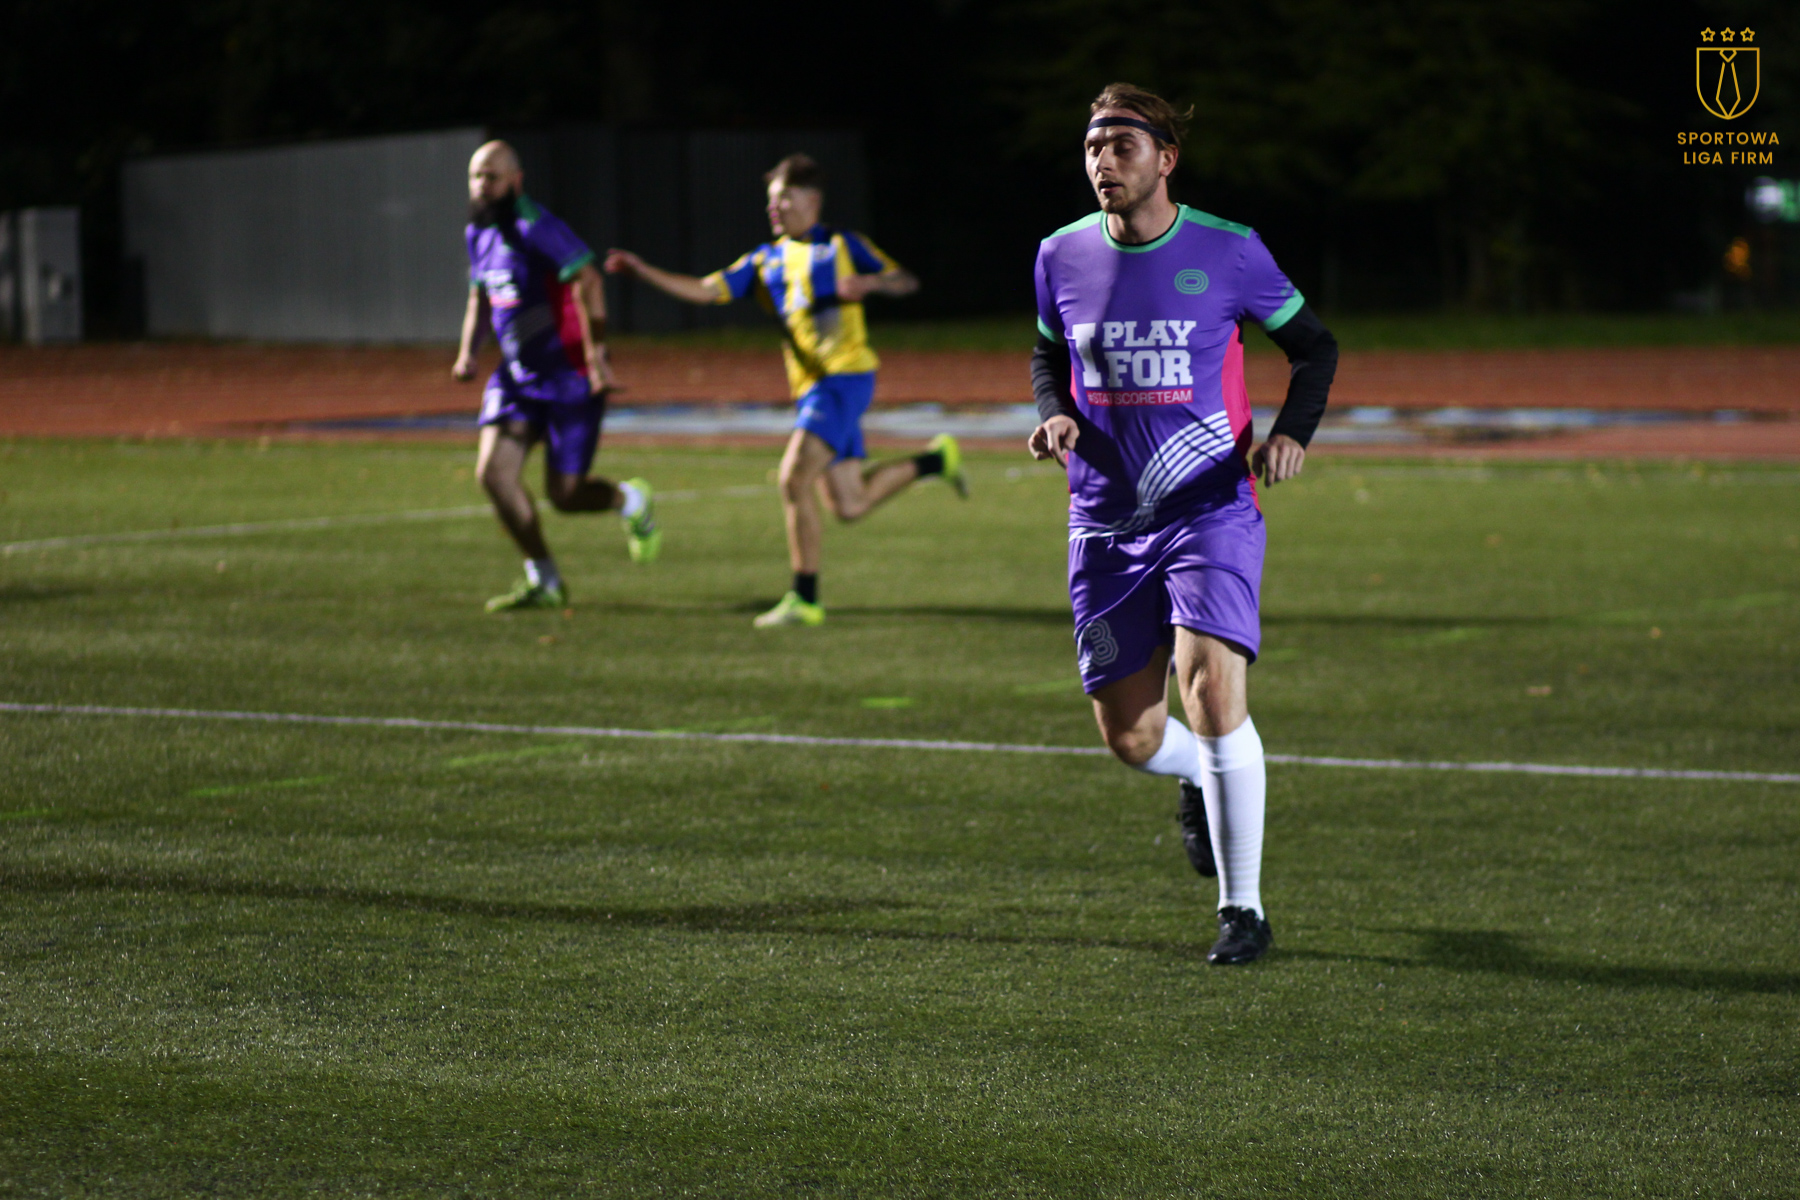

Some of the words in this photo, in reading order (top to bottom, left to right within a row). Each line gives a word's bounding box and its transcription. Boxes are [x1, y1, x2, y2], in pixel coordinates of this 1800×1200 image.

[1072, 322, 1102, 387] I
[1102, 320, 1197, 347] PLAY
[1104, 349, 1193, 388] FOR
